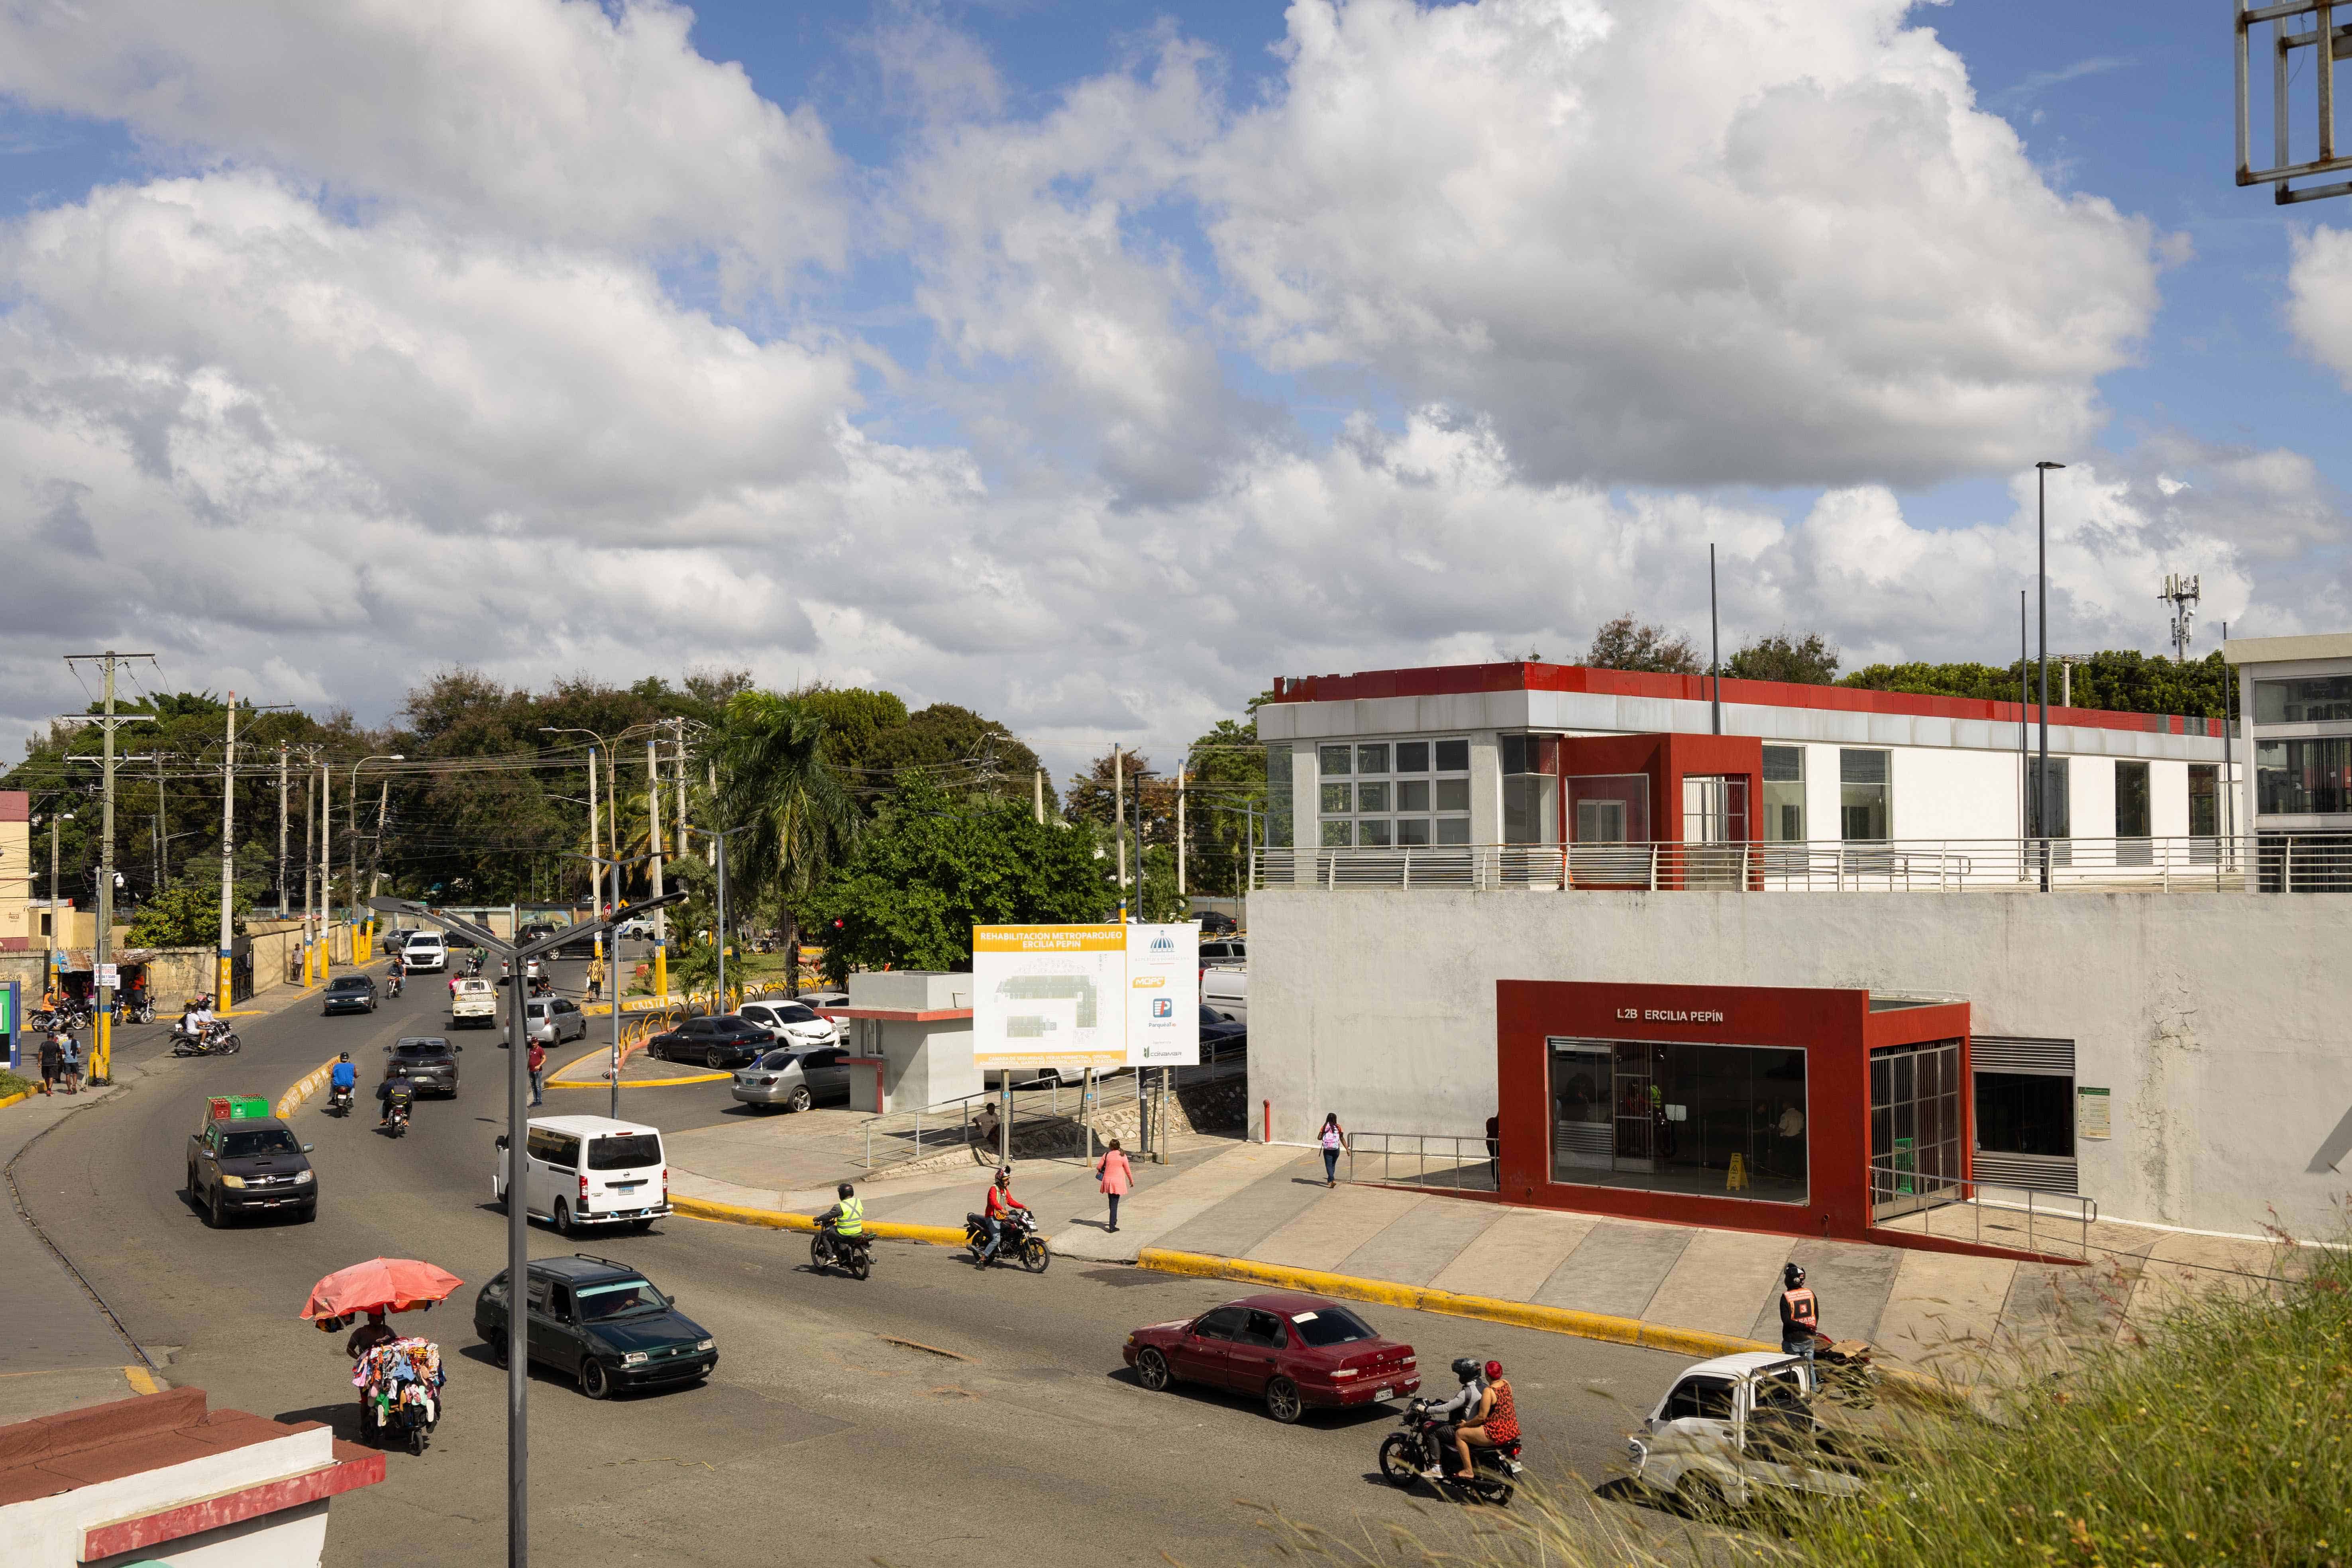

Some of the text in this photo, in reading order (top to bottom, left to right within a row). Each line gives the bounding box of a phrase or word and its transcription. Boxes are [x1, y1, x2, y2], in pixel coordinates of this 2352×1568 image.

[980, 931, 1123, 940] REHABILITACION METROPARQUEO
[632, 997, 664, 1010] CRISTO
[1617, 1009, 1723, 1022] L2B ERCILIA PEPÍN
